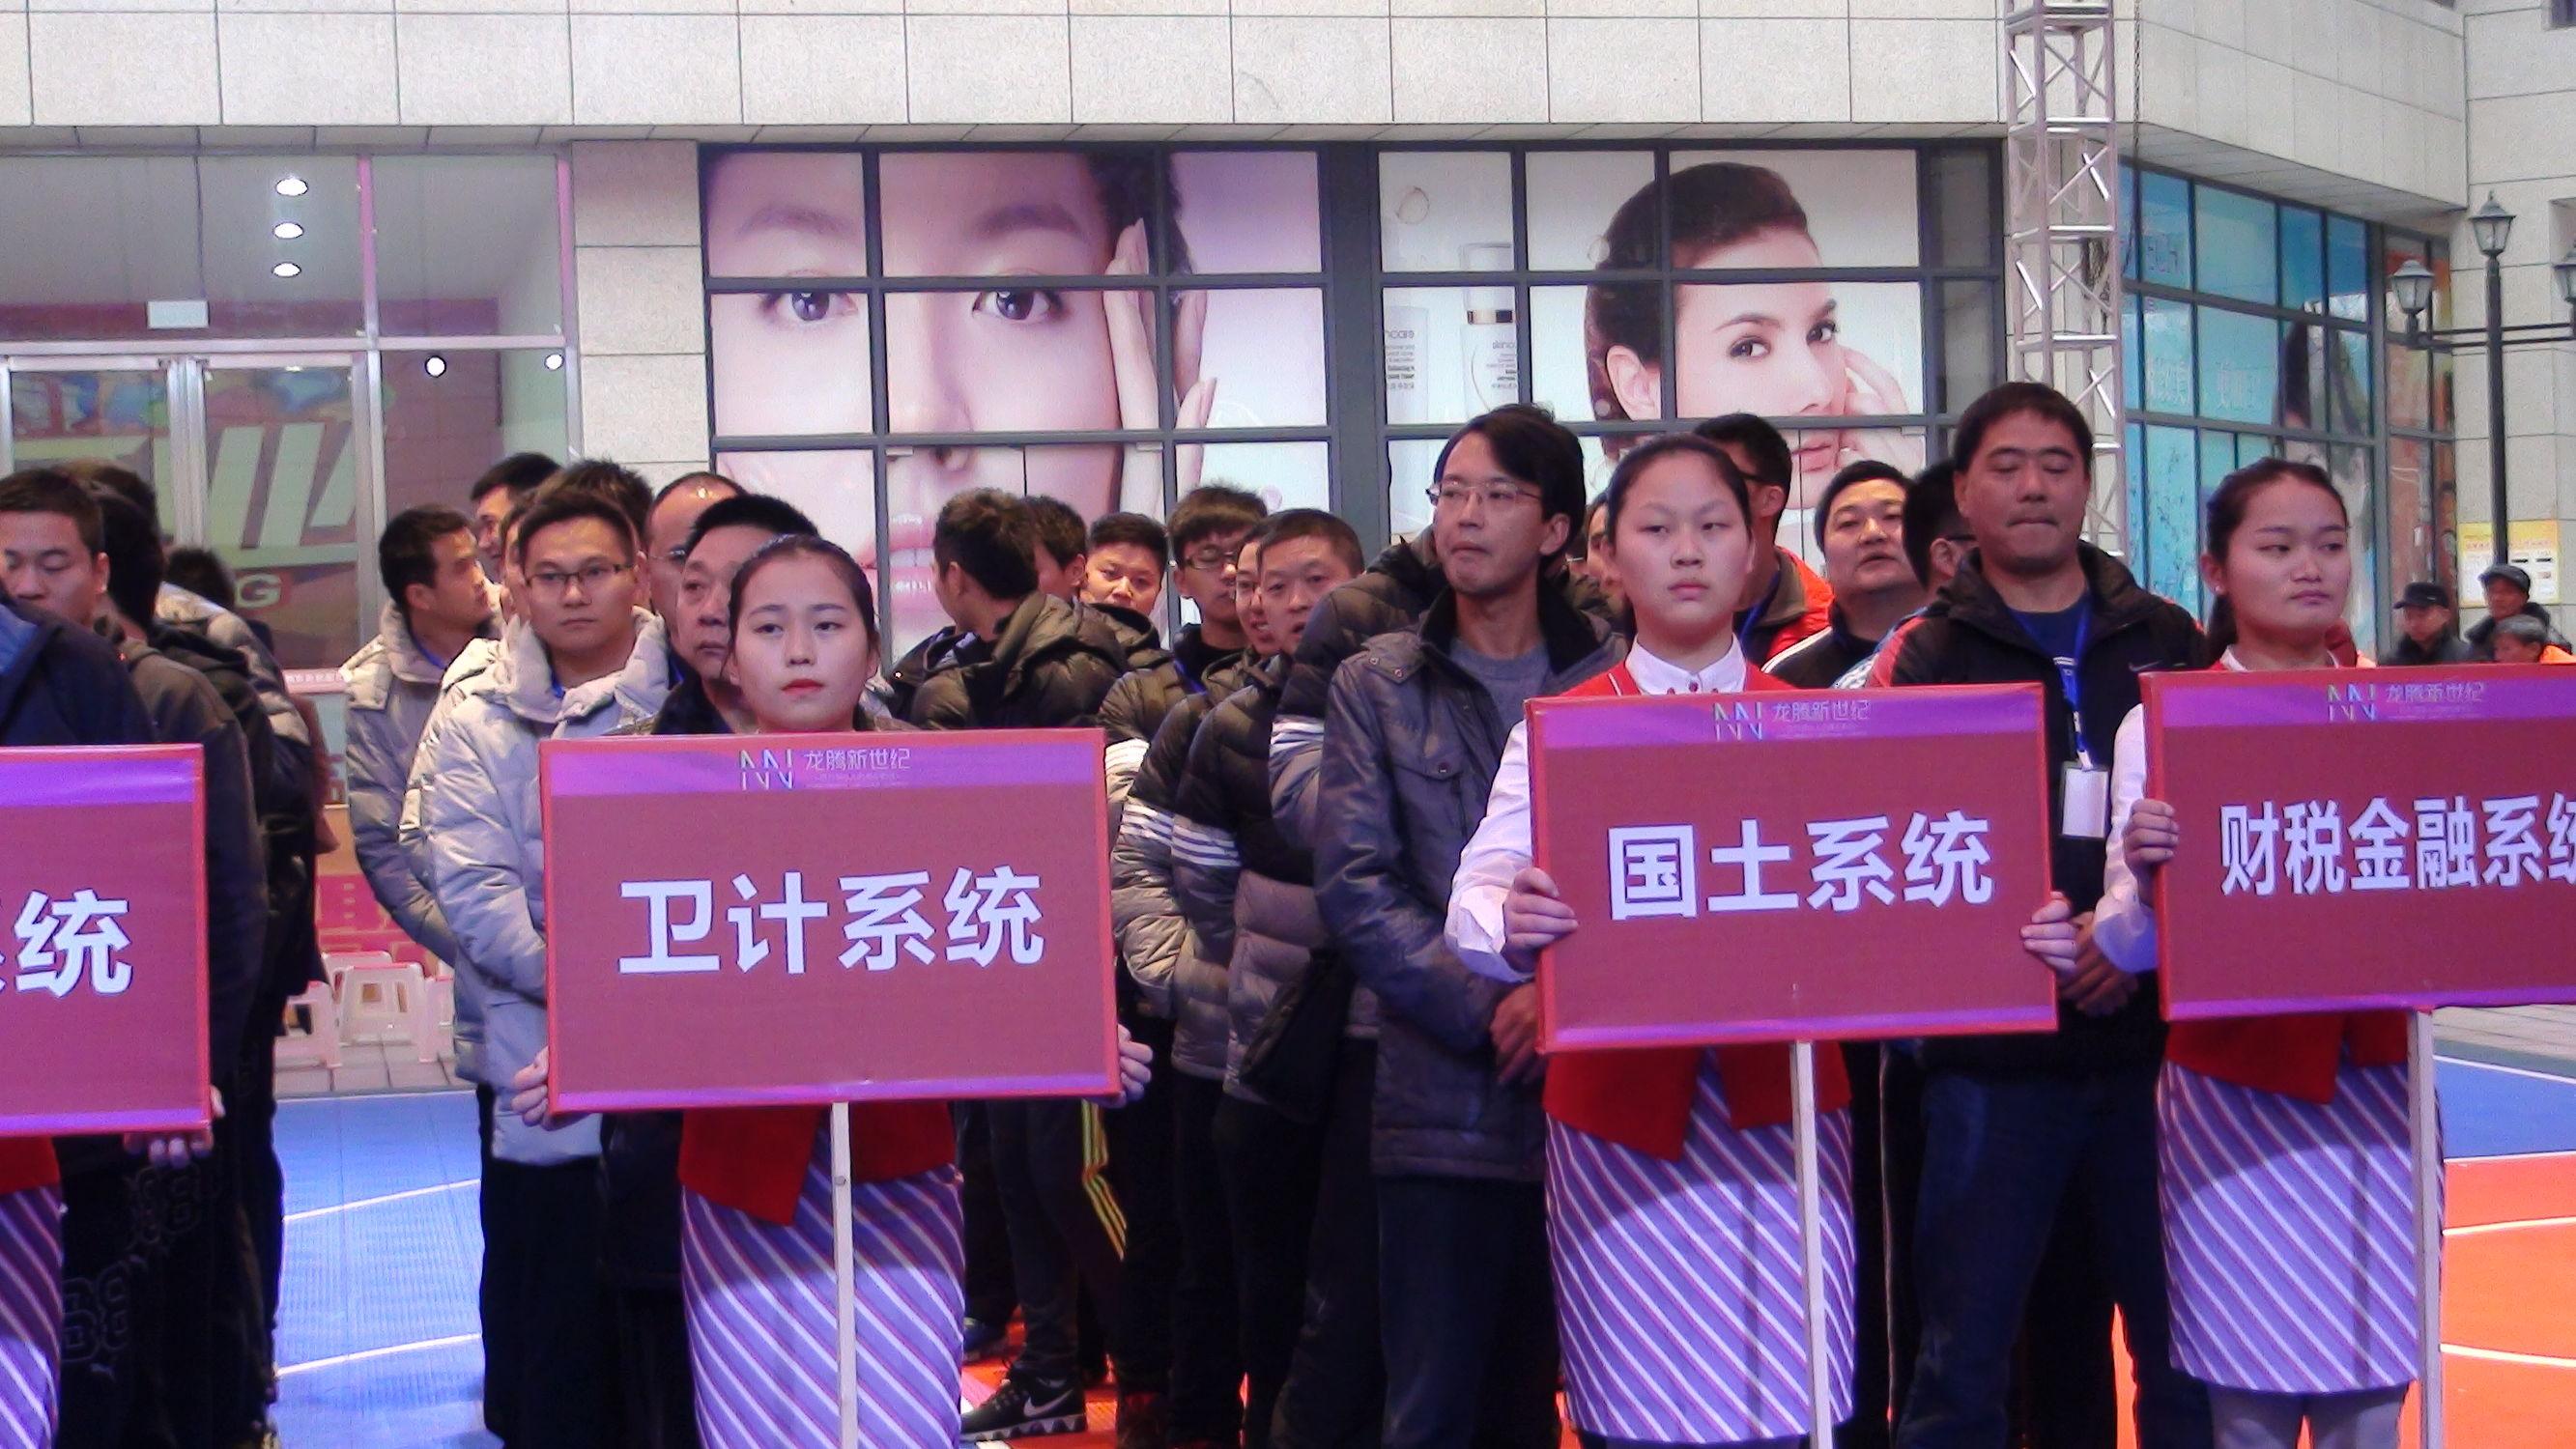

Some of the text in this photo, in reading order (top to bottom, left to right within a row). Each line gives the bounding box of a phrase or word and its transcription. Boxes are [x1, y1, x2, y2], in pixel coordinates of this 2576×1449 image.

[803, 748, 911, 772] 龙腾新世纪
[1771, 698, 1873, 723] 龙腾新世纪
[618, 865, 1045, 974] 卫计系统
[1608, 809, 1993, 921] 国土系统
[0, 888, 134, 998] 统
